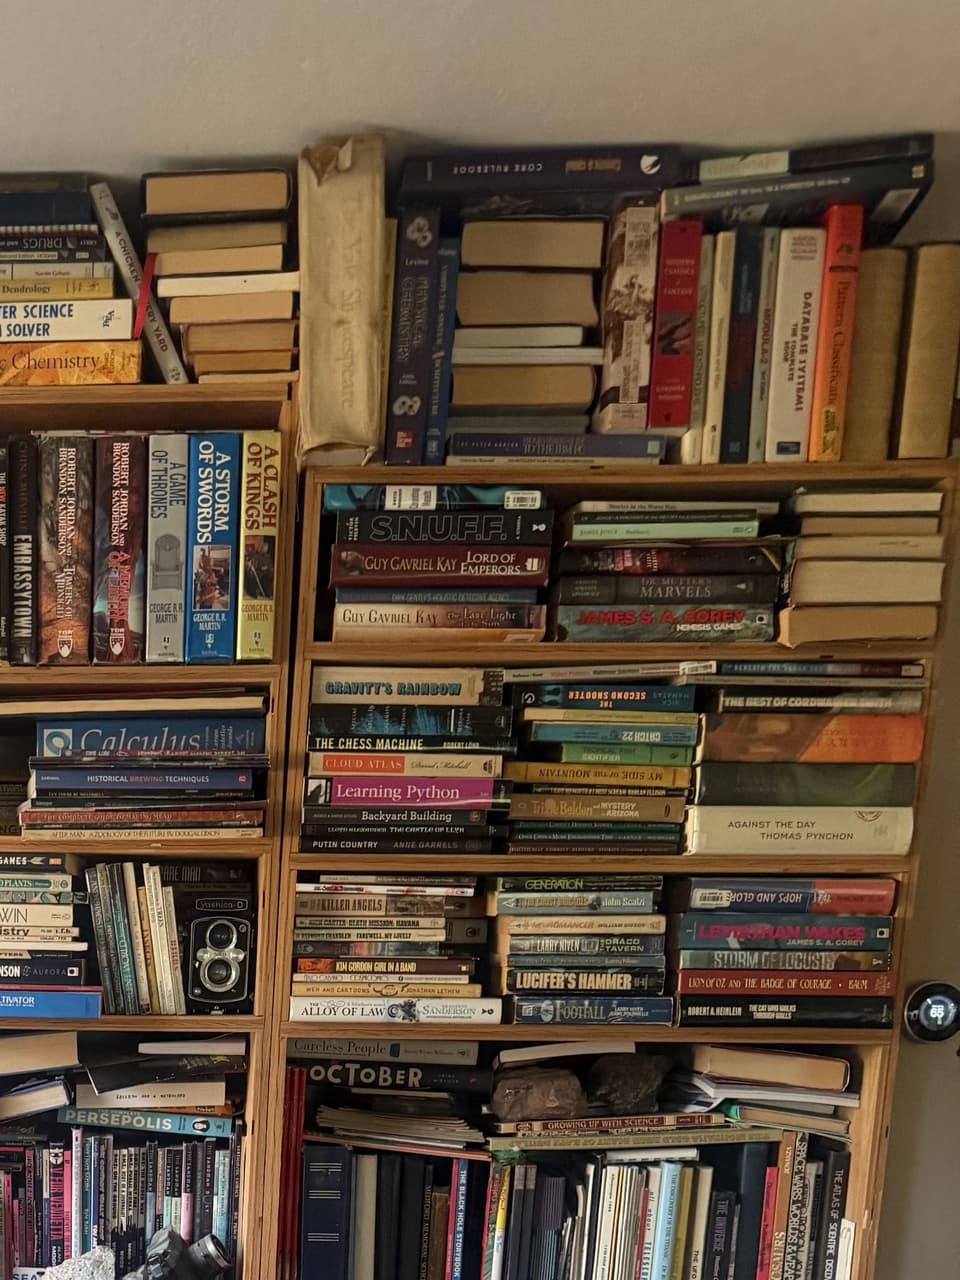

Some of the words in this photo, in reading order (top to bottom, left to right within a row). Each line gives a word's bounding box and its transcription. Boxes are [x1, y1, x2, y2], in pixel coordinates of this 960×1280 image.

[23, 304, 74, 319] SCIENCE
[6, 323, 50, 337] SOLVER
[152, 450, 168, 464] OF
[199, 440, 214, 465] OF
[216, 452, 224, 466] A
[248, 442, 262, 467] OF
[264, 446, 278, 458] A
[170, 462, 179, 470] A
[151, 466, 168, 520] THRONES
[169, 473, 186, 506] GAME
[262, 460, 277, 528] CLASH
[197, 468, 213, 543] SWORDS
[214, 468, 232, 532] STORM
[244, 470, 261, 530] KINGS
[364, 557, 389, 570] GUY
[390, 556, 434, 571] GAVRIEL
[436, 557, 457, 572] KAY
[467, 551, 499, 564] LORD
[500, 553, 516, 563] OF
[460, 562, 520, 575] EMPERORS
[13, 534, 32, 638] EMBASSYTOWN
[578, 611, 636, 625] JAMES
[640, 611, 656, 625] S.
[660, 611, 674, 625] A.
[684, 610, 744, 624] COREY
[325, 682, 393, 695] GRAVITY'S
[397, 682, 462, 696] RAINBOW
[79, 726, 200, 754] Calculus
[315, 738, 336, 750] THE
[338, 738, 372, 750] CHESS
[376, 739, 424, 750] MACHINE
[325, 759, 363, 769] CLOUD
[367, 759, 402, 769] ATLAS
[87, 775, 128, 783] HISTORICAL
[336, 784, 402, 801] Learning
[406, 785, 460, 802] Python
[361, 811, 407, 822] Backyard
[409, 812, 452, 822] Building
[728, 821, 770, 829] AGAINST
[775, 821, 793, 829] THE
[796, 821, 816, 829] DAY
[760, 832, 802, 841] THOMAS
[806, 832, 853, 841] PYNCHON
[313, 840, 337, 849] PUTIN
[340, 841, 378, 849] COUNTRY
[525, 879, 584, 890] GENERATION
[516, 972, 577, 989] LUCIFER'S
[579, 974, 632, 990] HAMMER
[309, 1063, 423, 1088] OCTOBER
[65, 1110, 172, 1130] PERSEPOLIS
